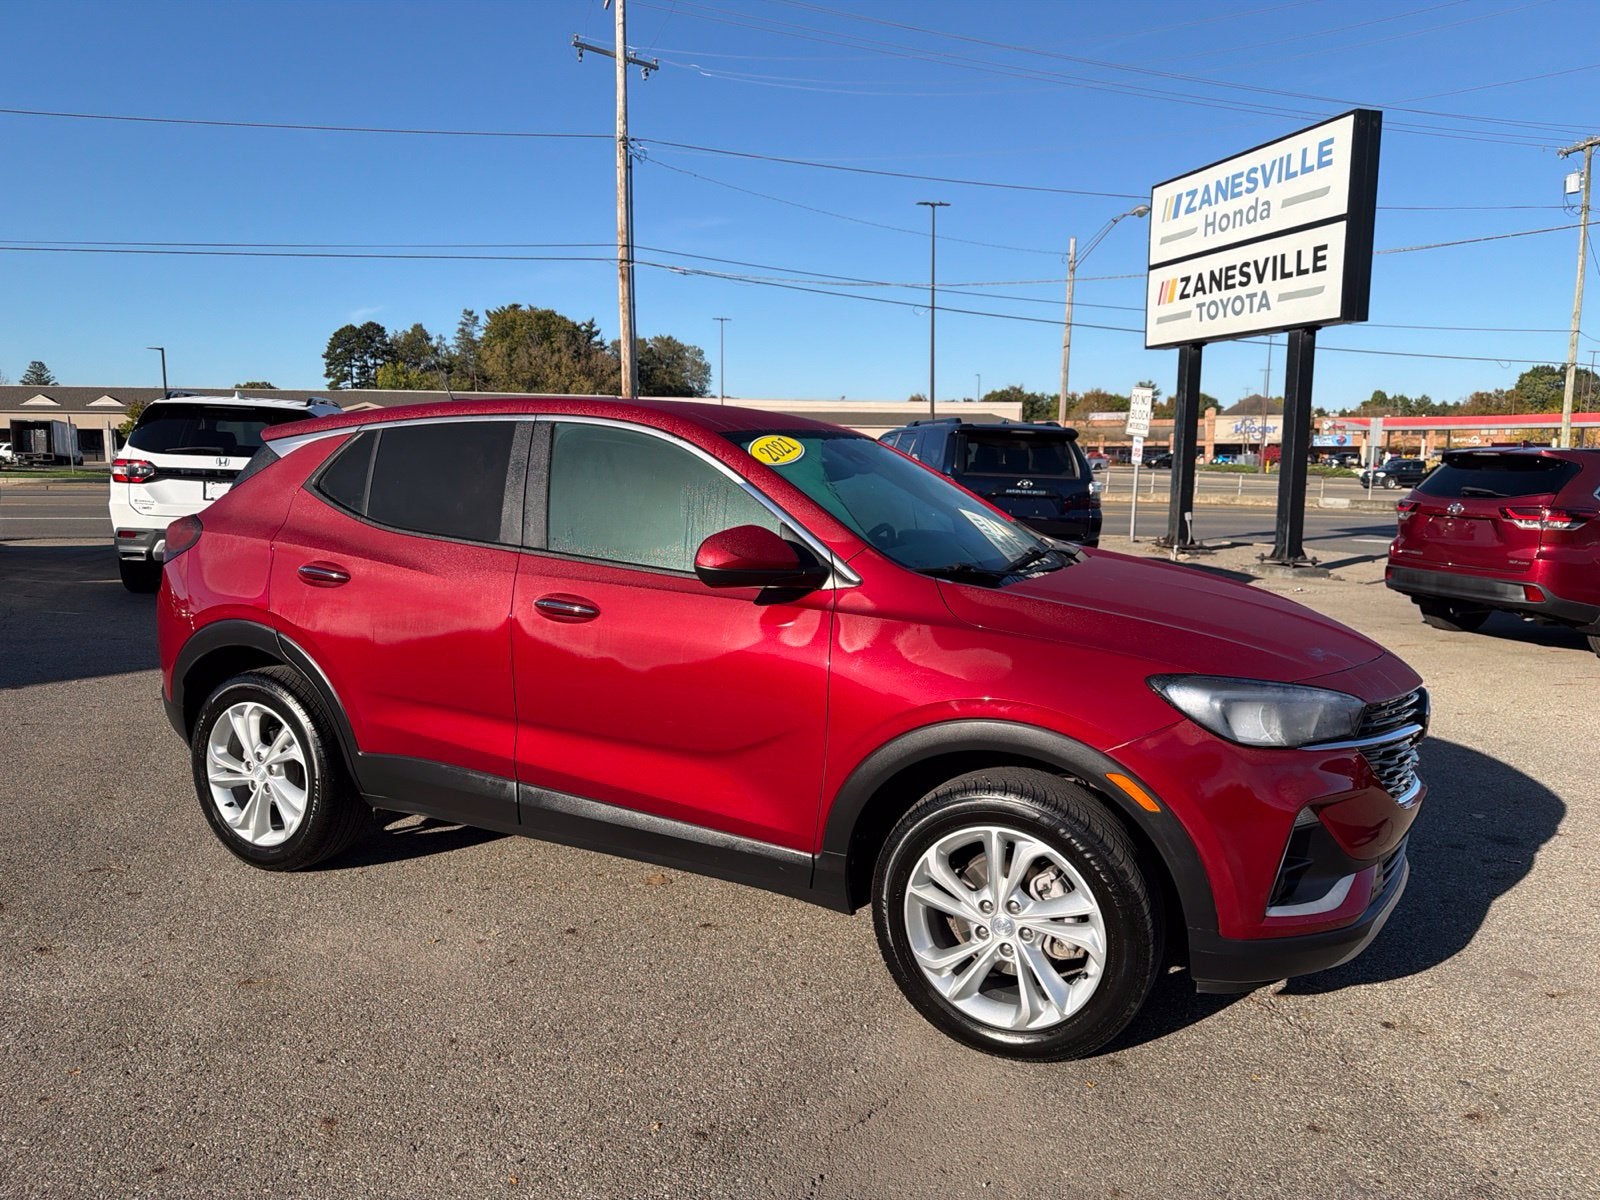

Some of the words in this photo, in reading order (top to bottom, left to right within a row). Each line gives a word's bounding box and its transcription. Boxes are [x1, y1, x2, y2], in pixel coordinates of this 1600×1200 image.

[1184, 137, 1335, 215] ZANESVILLE
[1204, 198, 1271, 237] Honda
[1179, 244, 1328, 300] ZANESVILLE
[1196, 290, 1271, 322] TOYOTA
[1131, 408, 1149, 421] BLOCK
[1234, 417, 1278, 441] Kroger
[758, 437, 797, 462] 2021
